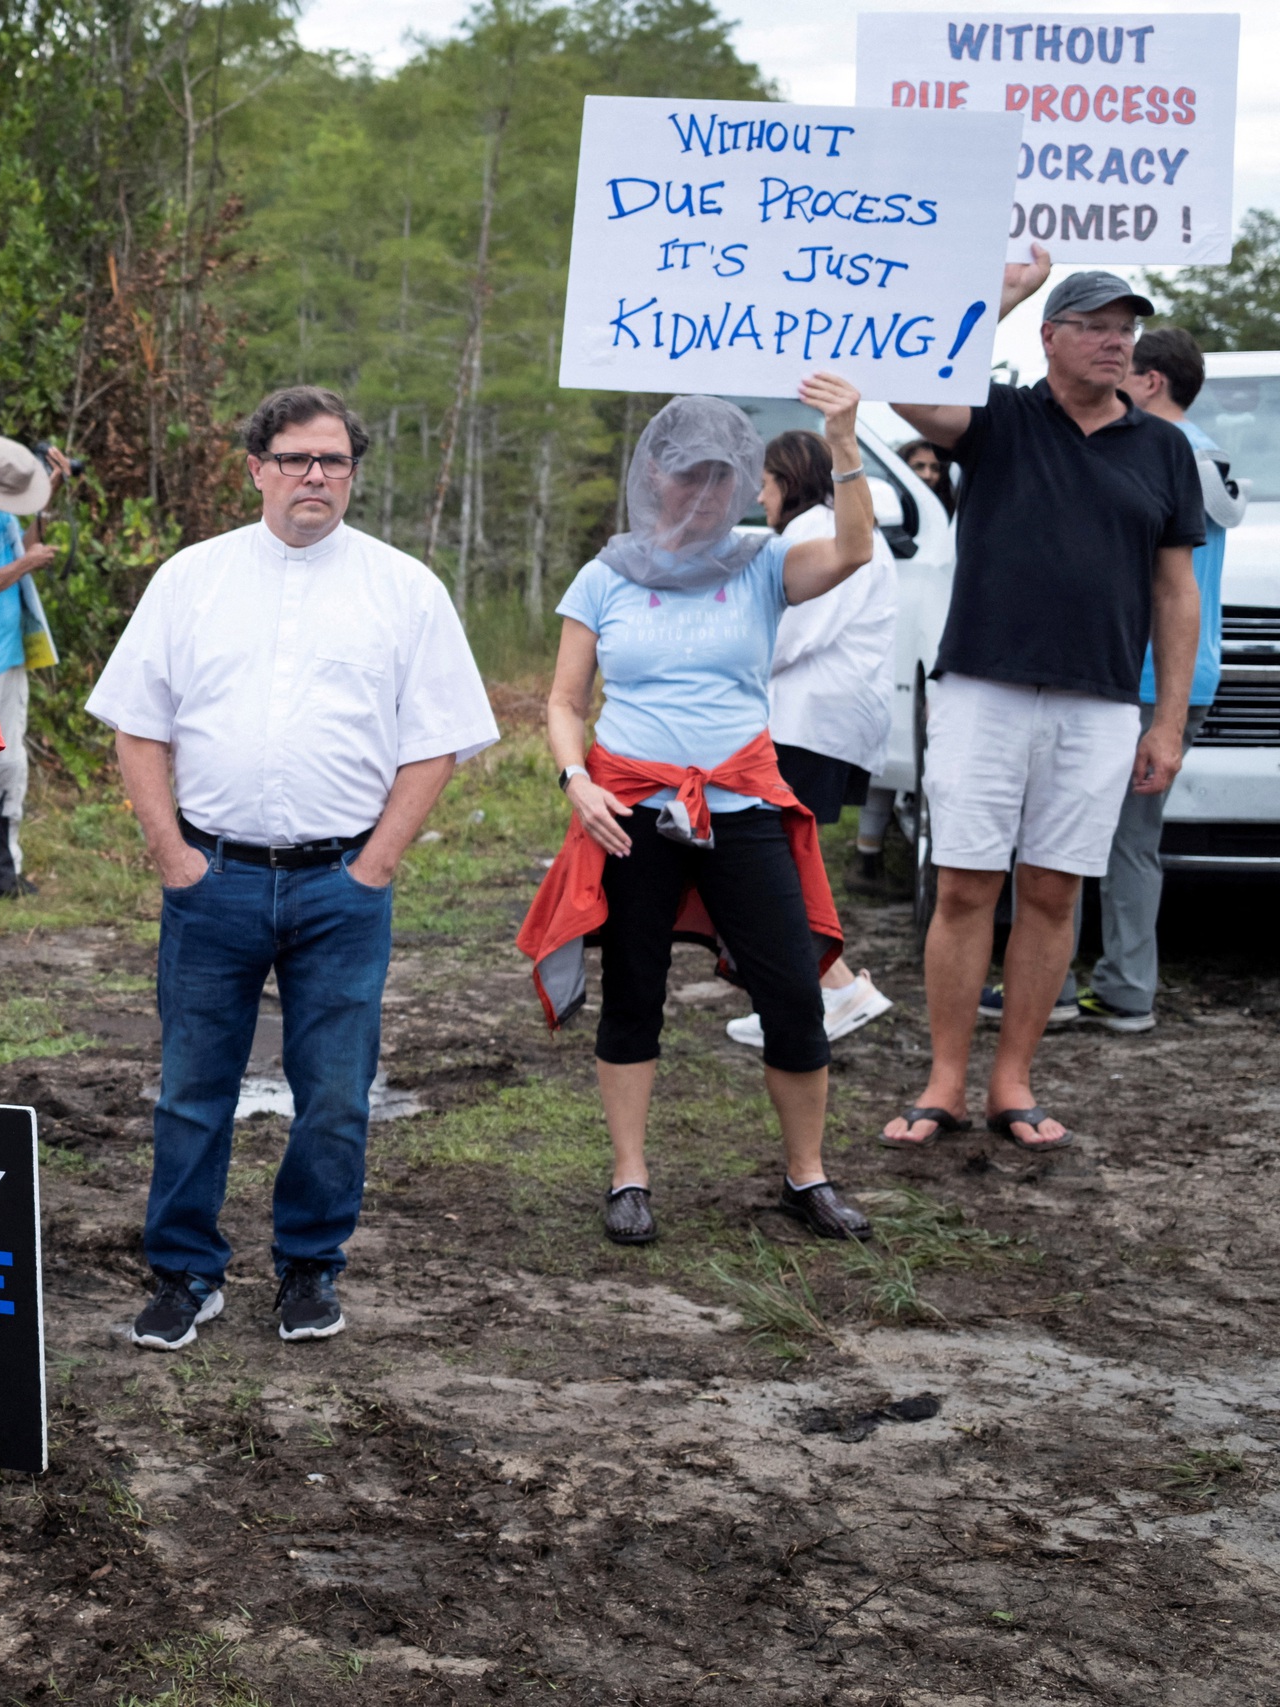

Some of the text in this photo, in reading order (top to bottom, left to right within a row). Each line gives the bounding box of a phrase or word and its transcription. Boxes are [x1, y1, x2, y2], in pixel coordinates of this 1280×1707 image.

[948, 22, 1155, 65] WITHOUT
[1006, 84, 1196, 125] PROCESS
[668, 112, 856, 158] WITHOUT
[1017, 142, 1189, 187] OCRACY
[606, 176, 939, 227] DUE PROCESS
[1009, 202, 1158, 242] OOMED
[656, 237, 910, 289] IT'S JUST
